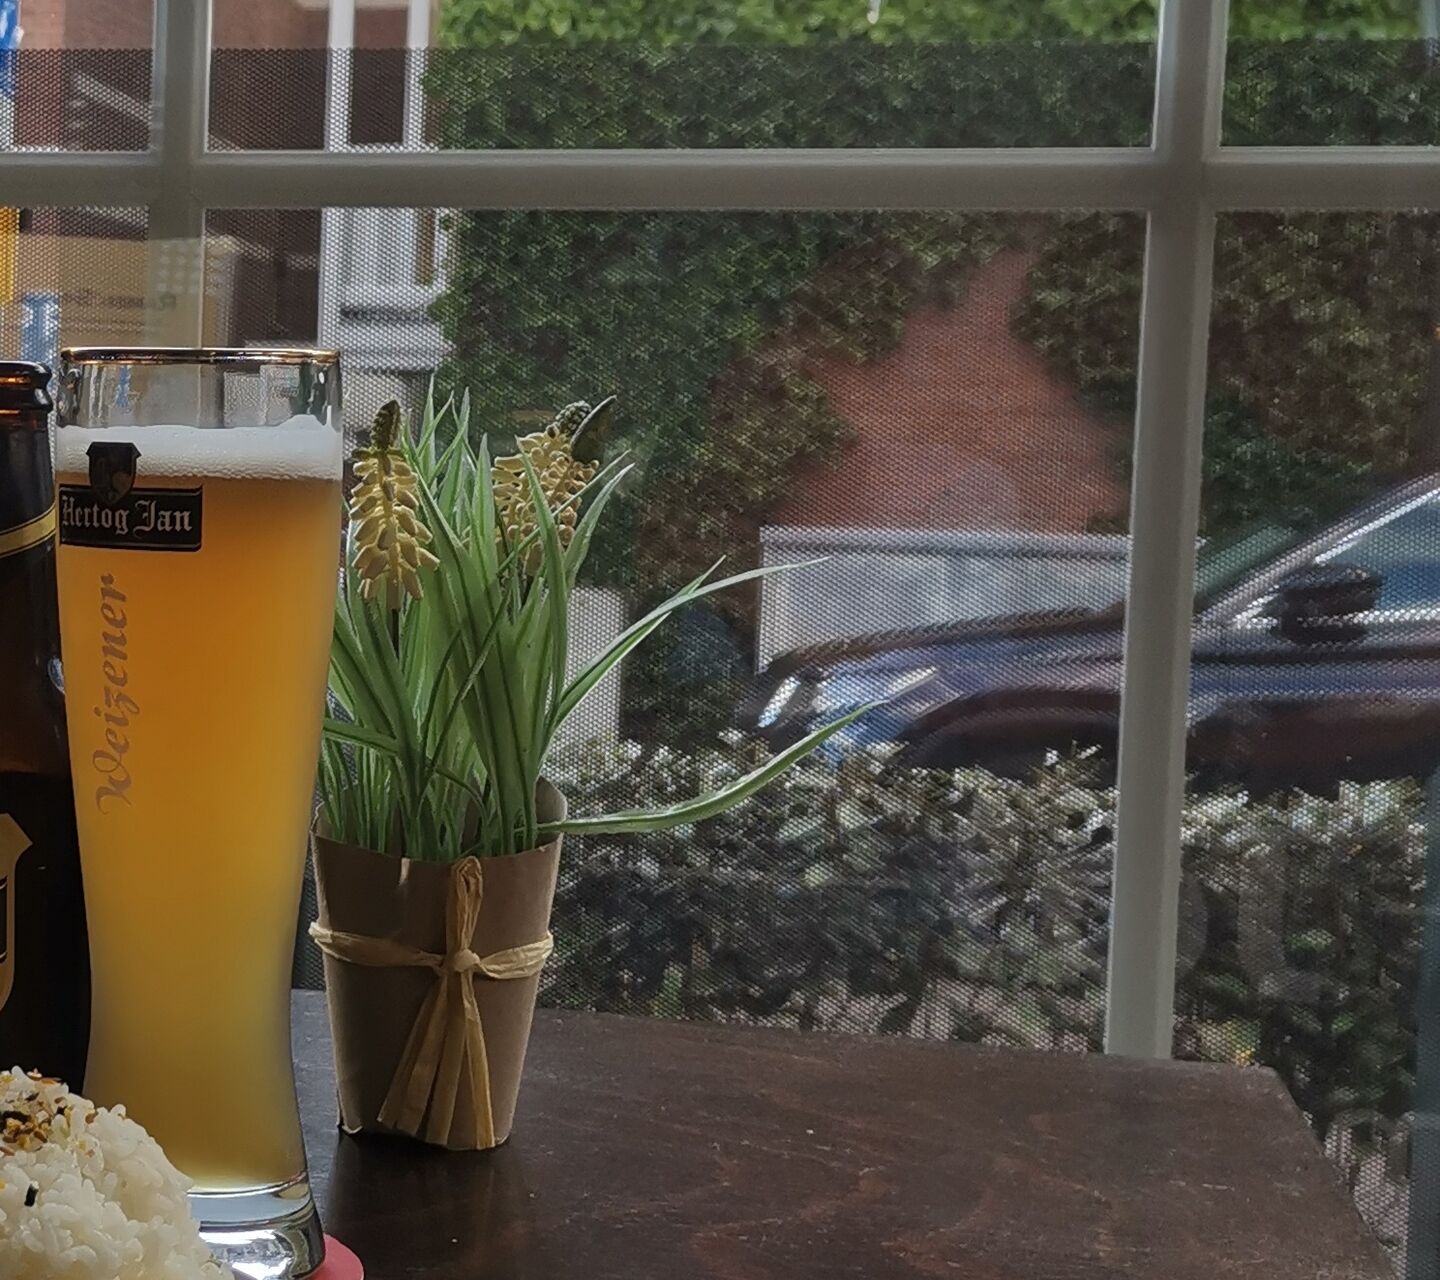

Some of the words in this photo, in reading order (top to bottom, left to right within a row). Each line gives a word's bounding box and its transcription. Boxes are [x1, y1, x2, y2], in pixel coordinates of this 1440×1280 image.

[60, 494, 129, 536] Hertog
[132, 498, 194, 537] Jan
[92, 571, 141, 816] Weizener
